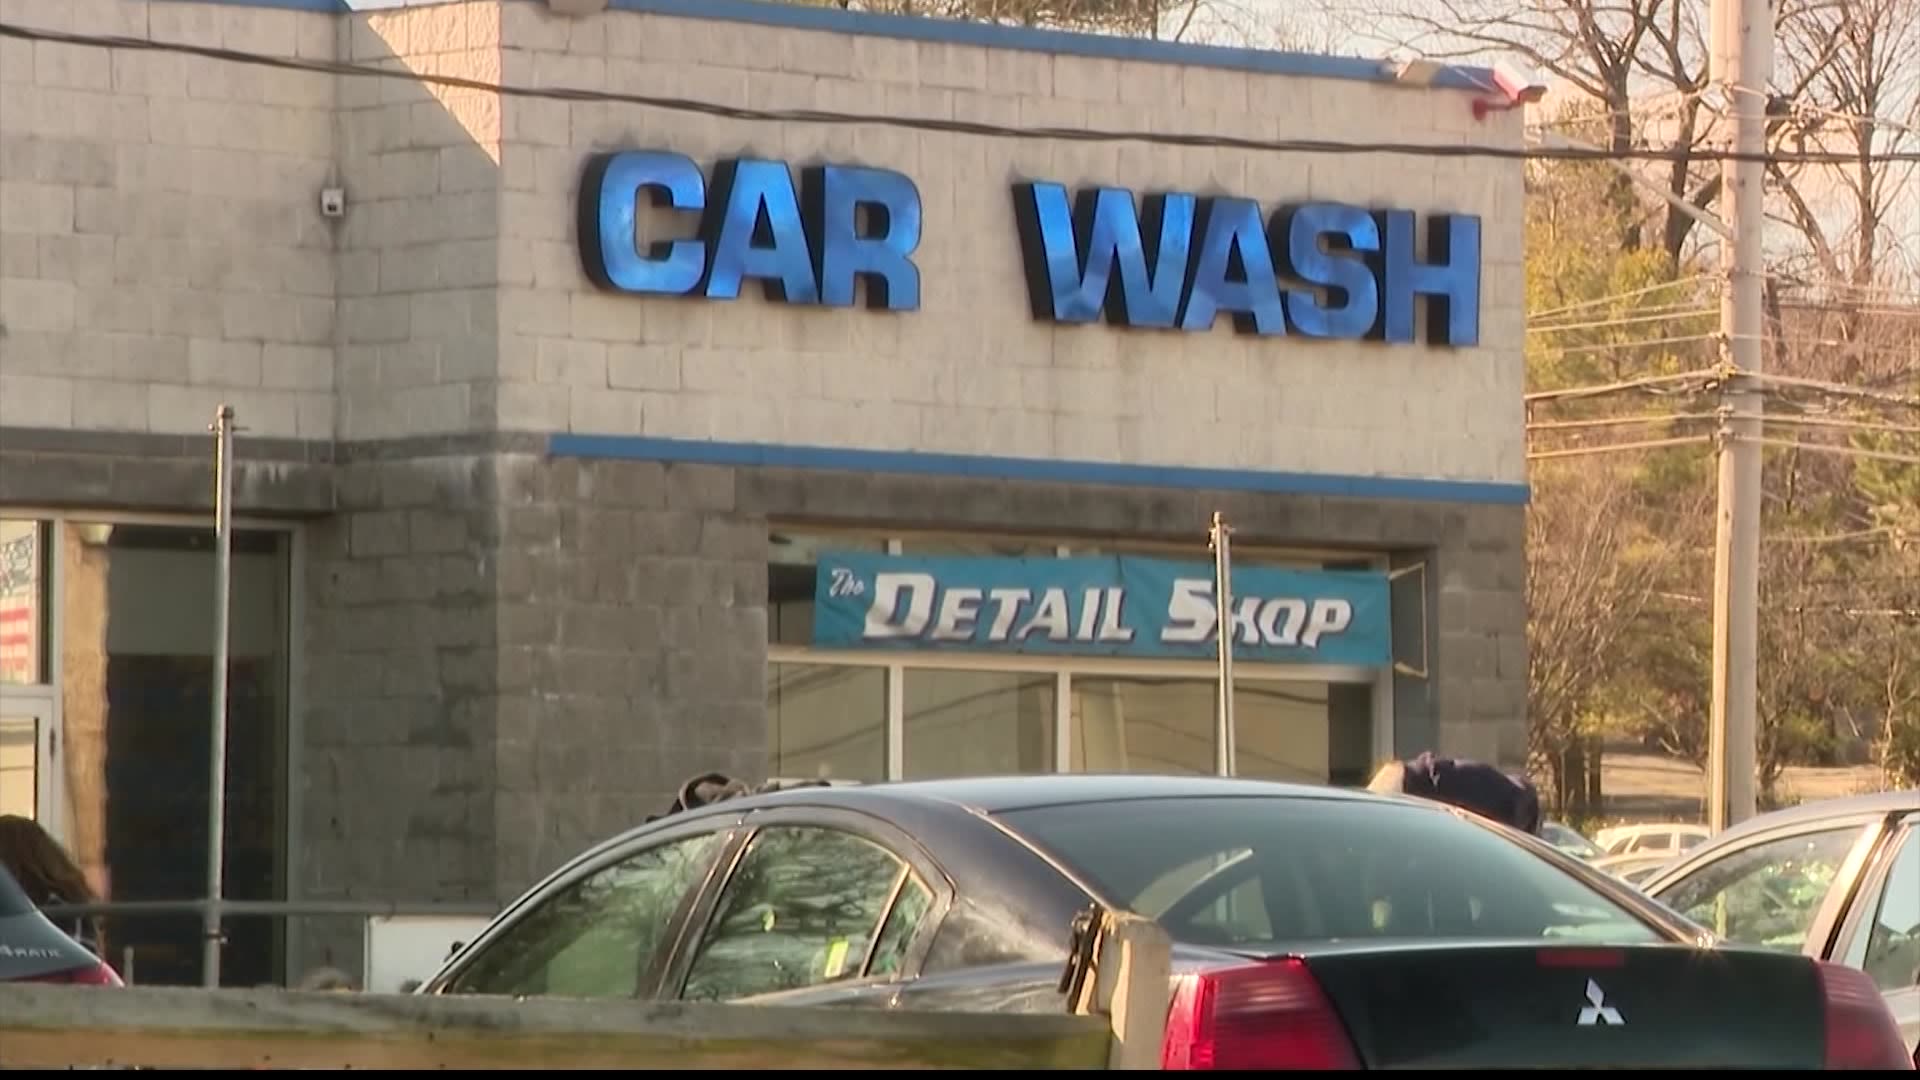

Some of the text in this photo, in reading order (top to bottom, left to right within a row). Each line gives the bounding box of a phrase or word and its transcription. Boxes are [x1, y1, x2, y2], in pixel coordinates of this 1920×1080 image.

[584, 150, 1482, 347] CAR WASH
[829, 568, 1352, 647] The DETAIL SHOP
